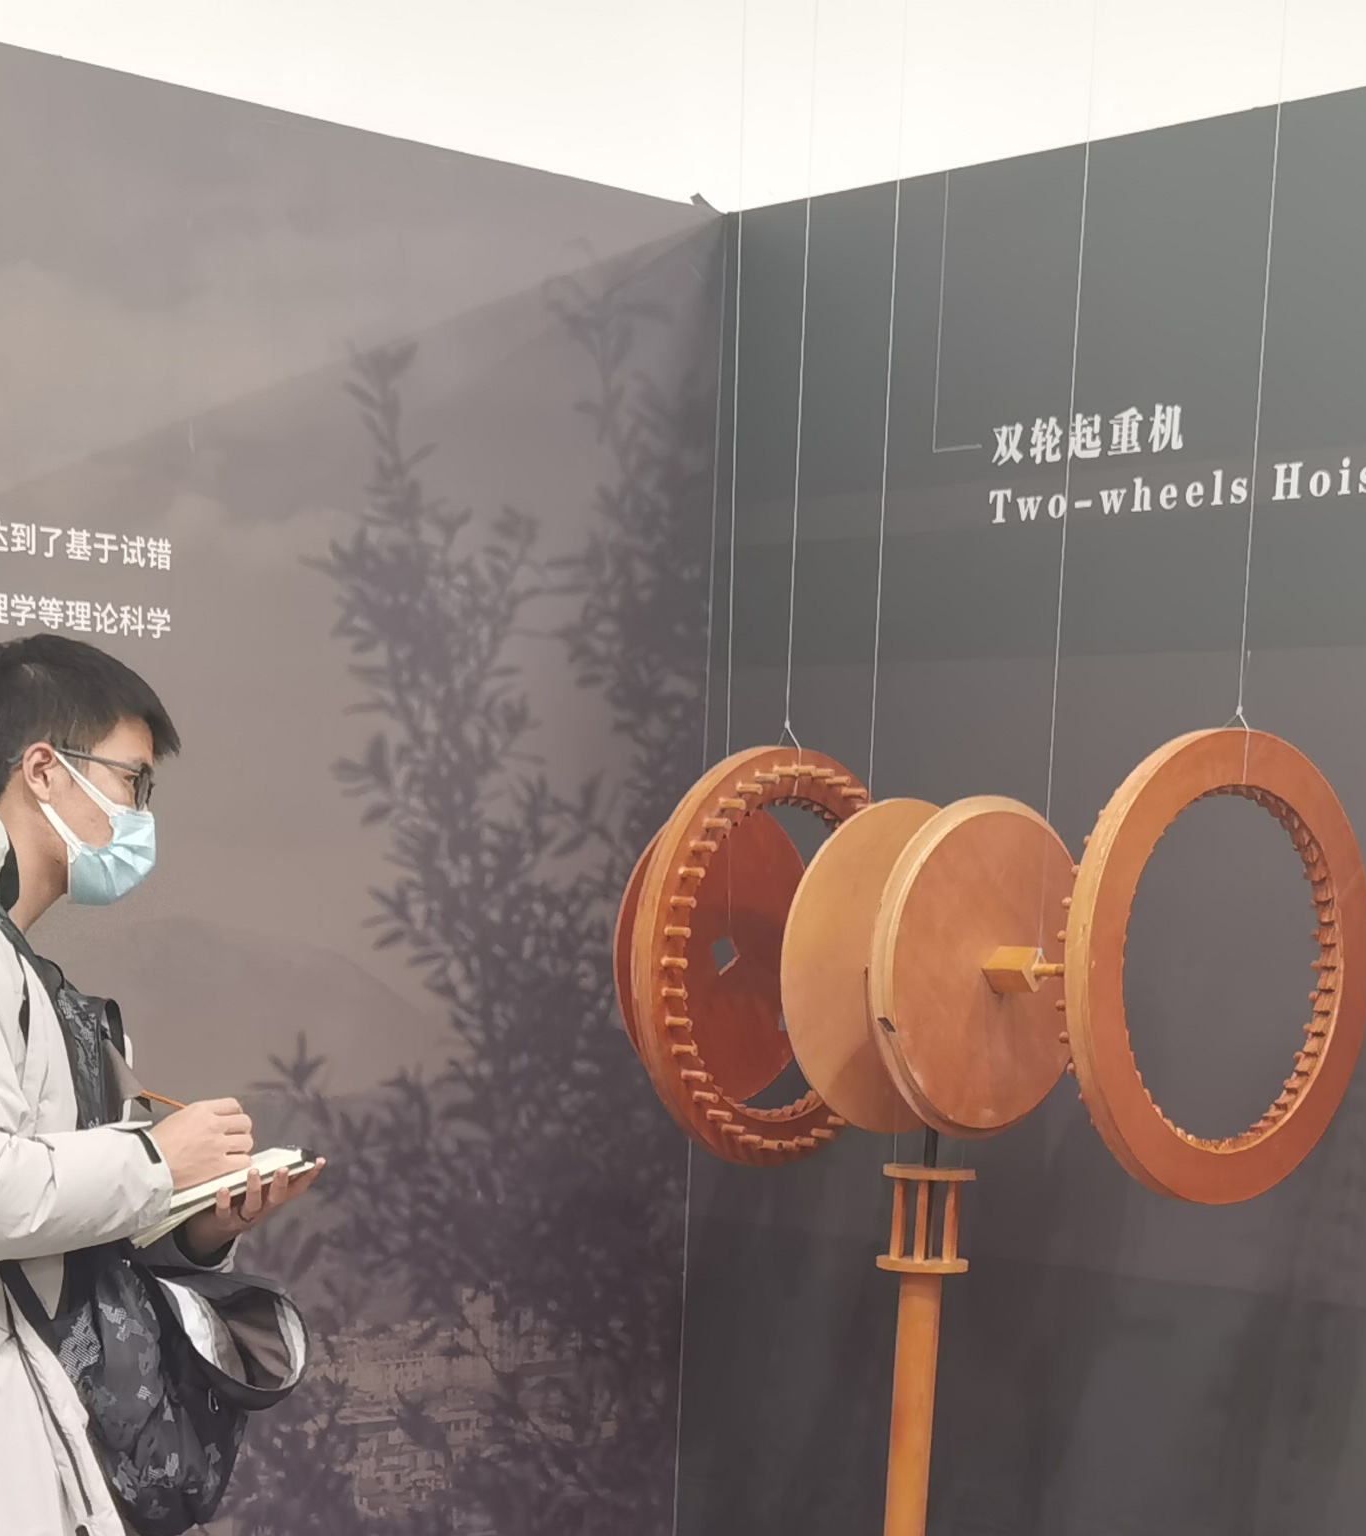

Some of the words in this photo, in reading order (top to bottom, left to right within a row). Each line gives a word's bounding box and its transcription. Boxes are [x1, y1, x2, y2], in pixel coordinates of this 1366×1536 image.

[991, 403, 1184, 467] 双轮起重机
[989, 470, 1249, 523] Two-wheels
